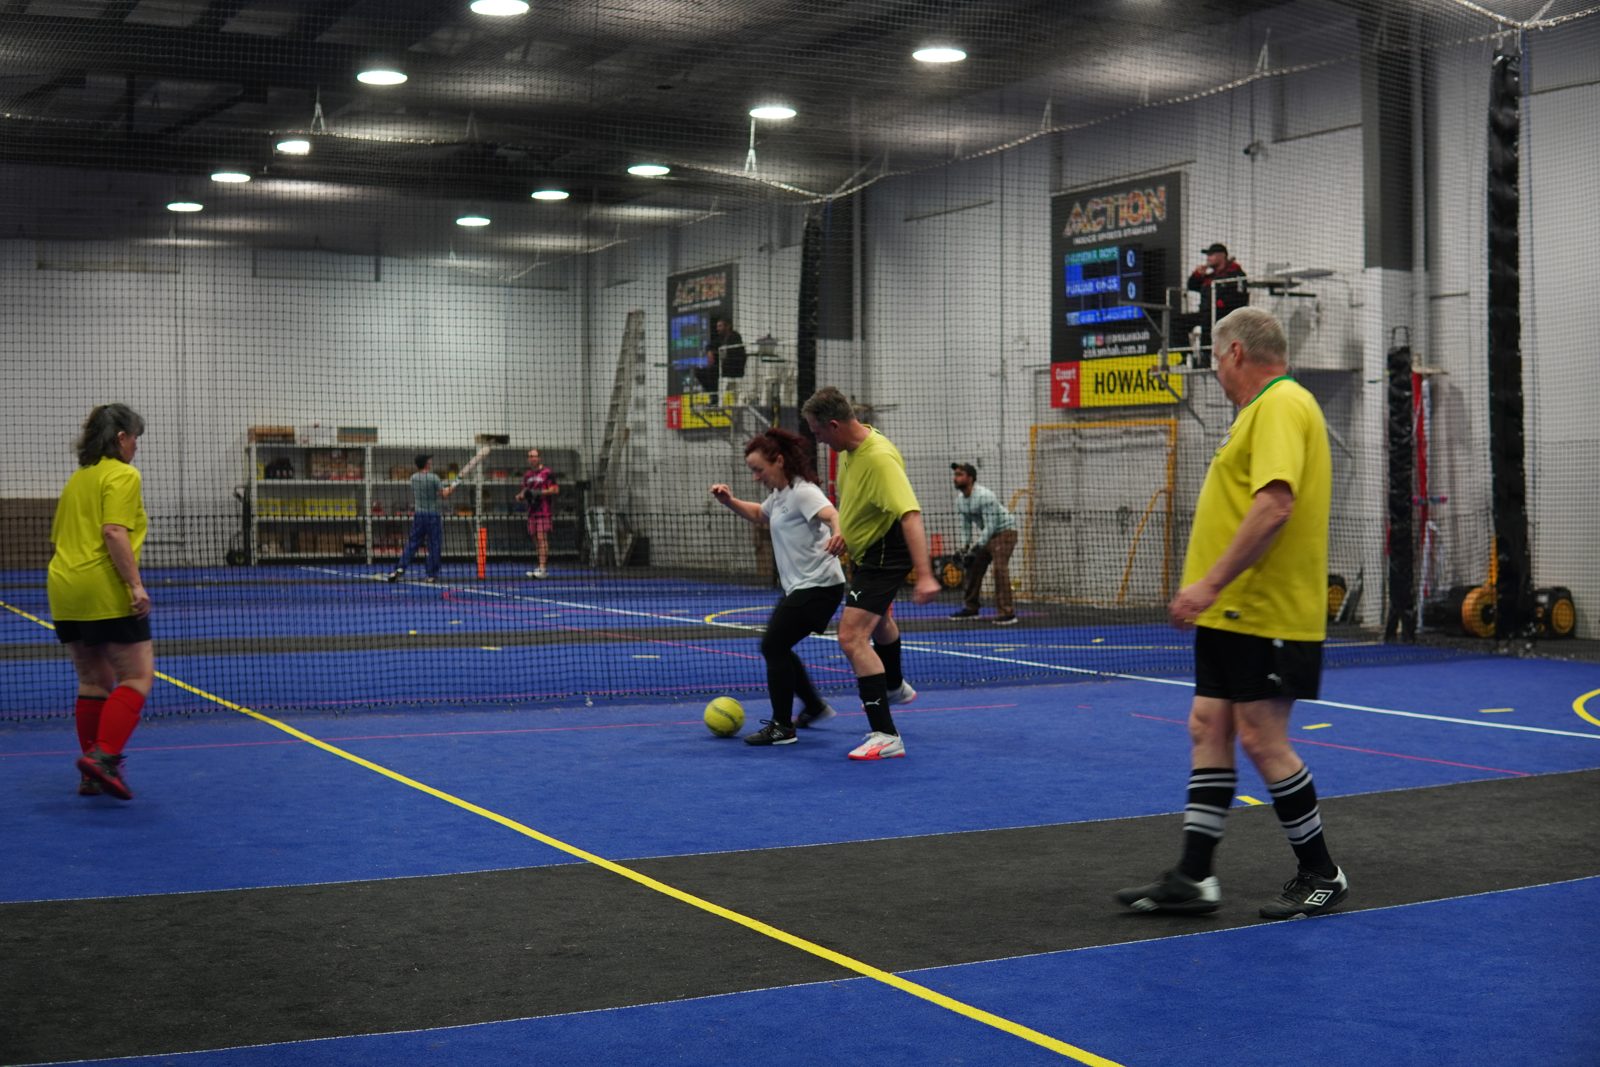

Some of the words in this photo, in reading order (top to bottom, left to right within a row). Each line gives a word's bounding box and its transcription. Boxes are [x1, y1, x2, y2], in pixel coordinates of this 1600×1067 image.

[1063, 186, 1166, 237] ACTION
[1126, 249, 1135, 268] 0
[1127, 281, 1136, 299] 0
[1061, 382, 1070, 403] 2
